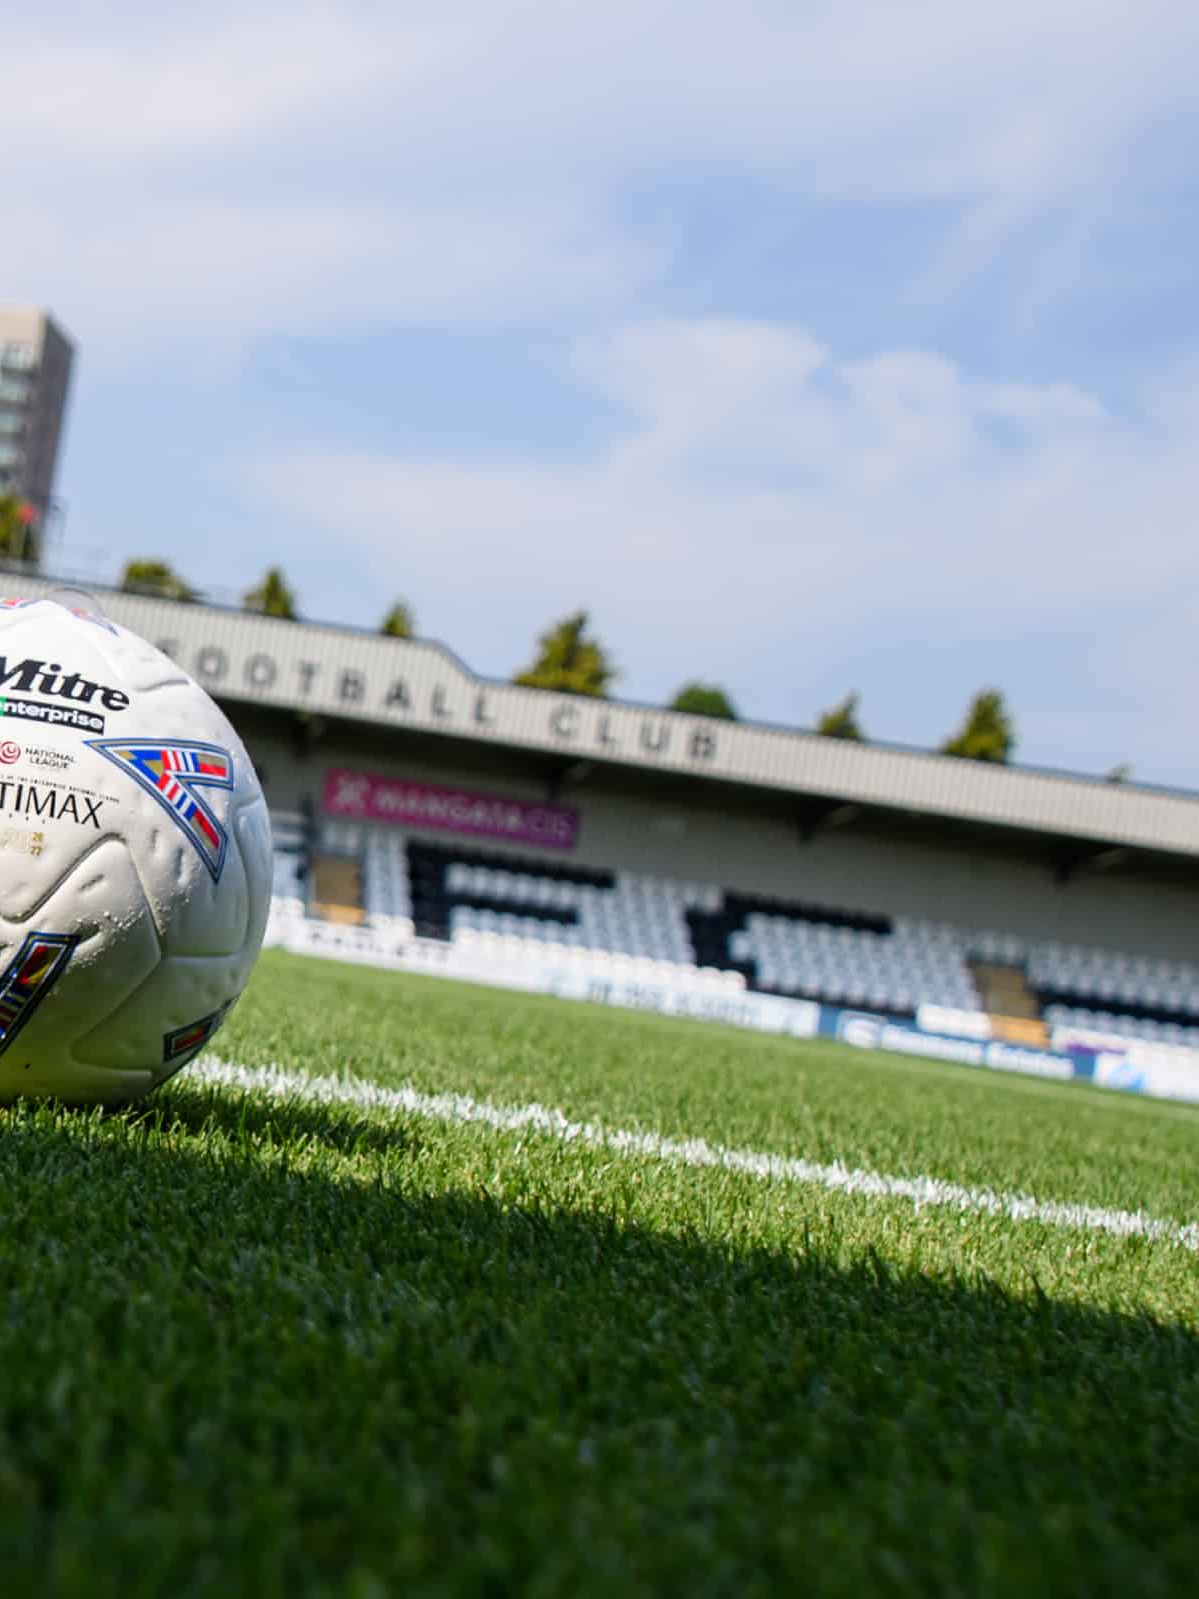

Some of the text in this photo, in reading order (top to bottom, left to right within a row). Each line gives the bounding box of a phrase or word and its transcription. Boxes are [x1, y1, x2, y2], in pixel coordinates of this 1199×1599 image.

[548, 702, 719, 760] CLUB
[24, 746, 76, 763] NATIONAL
[29, 756, 71, 769] LEAGUE
